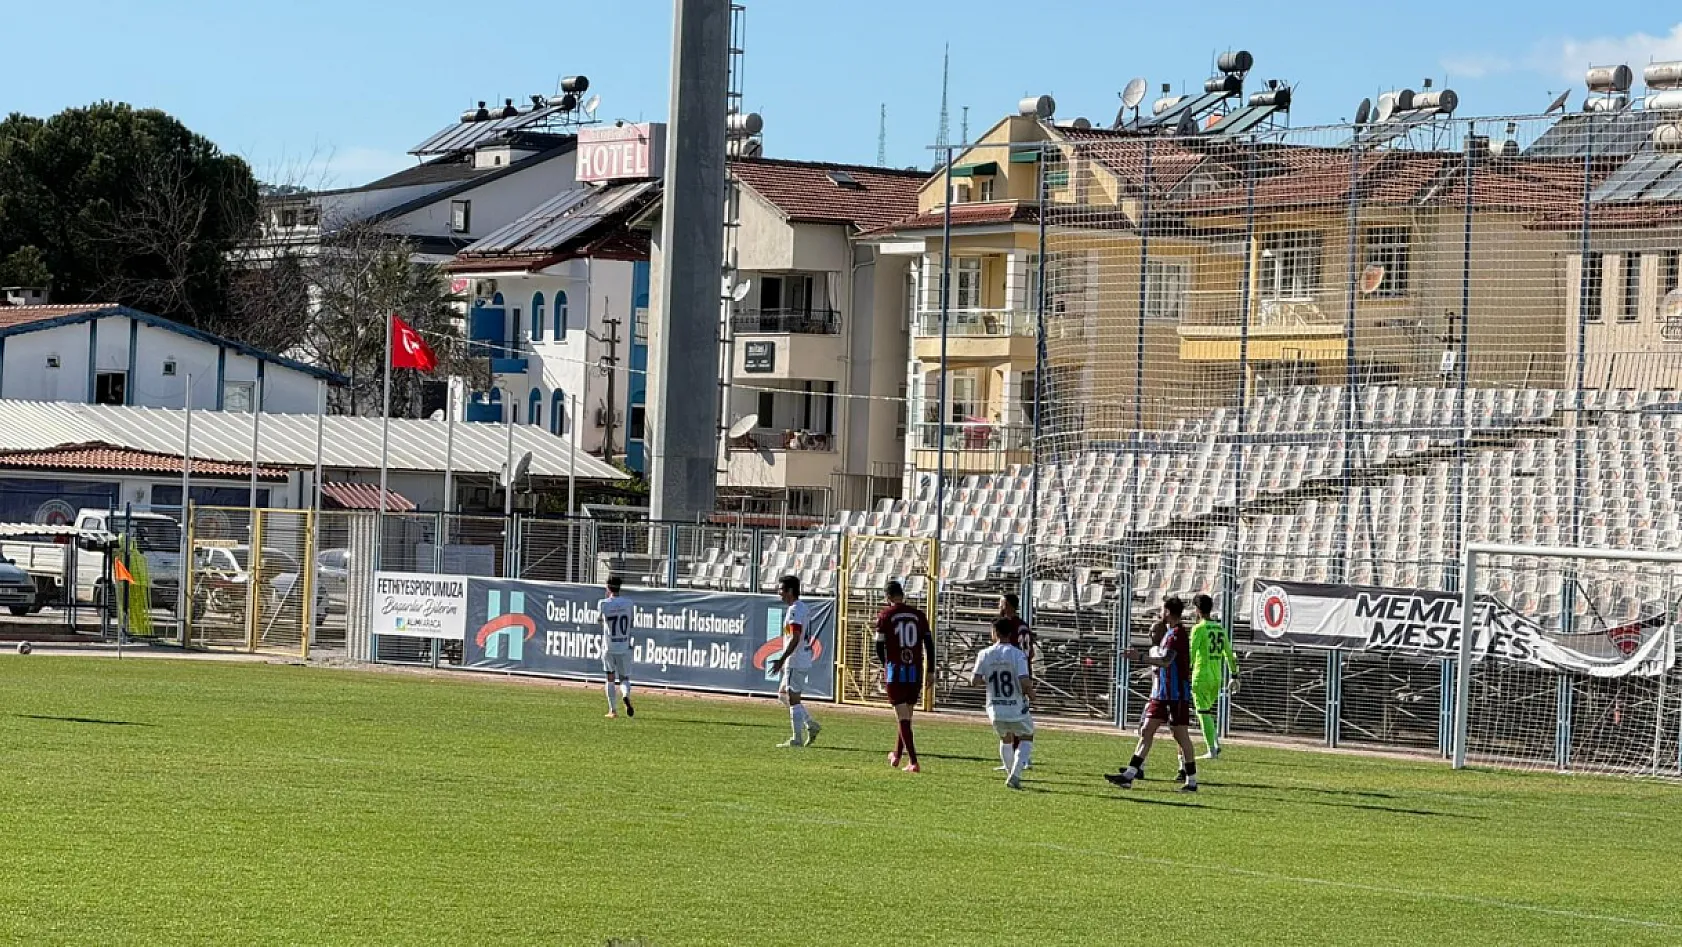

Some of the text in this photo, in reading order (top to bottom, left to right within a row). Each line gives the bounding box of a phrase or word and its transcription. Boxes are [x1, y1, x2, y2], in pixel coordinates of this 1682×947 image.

[578, 142, 646, 176] HOTEL
[546, 595, 569, 622] Özel
[572, 602, 600, 624] Lokm
[656, 607, 687, 631] Esnaf
[689, 610, 745, 635] Hastanesi
[607, 615, 628, 636] 70
[894, 621, 918, 648] 10
[1208, 631, 1225, 654] 35
[645, 638, 707, 672] Başarılar
[710, 642, 743, 669] Diler
[989, 670, 1014, 697] 18
